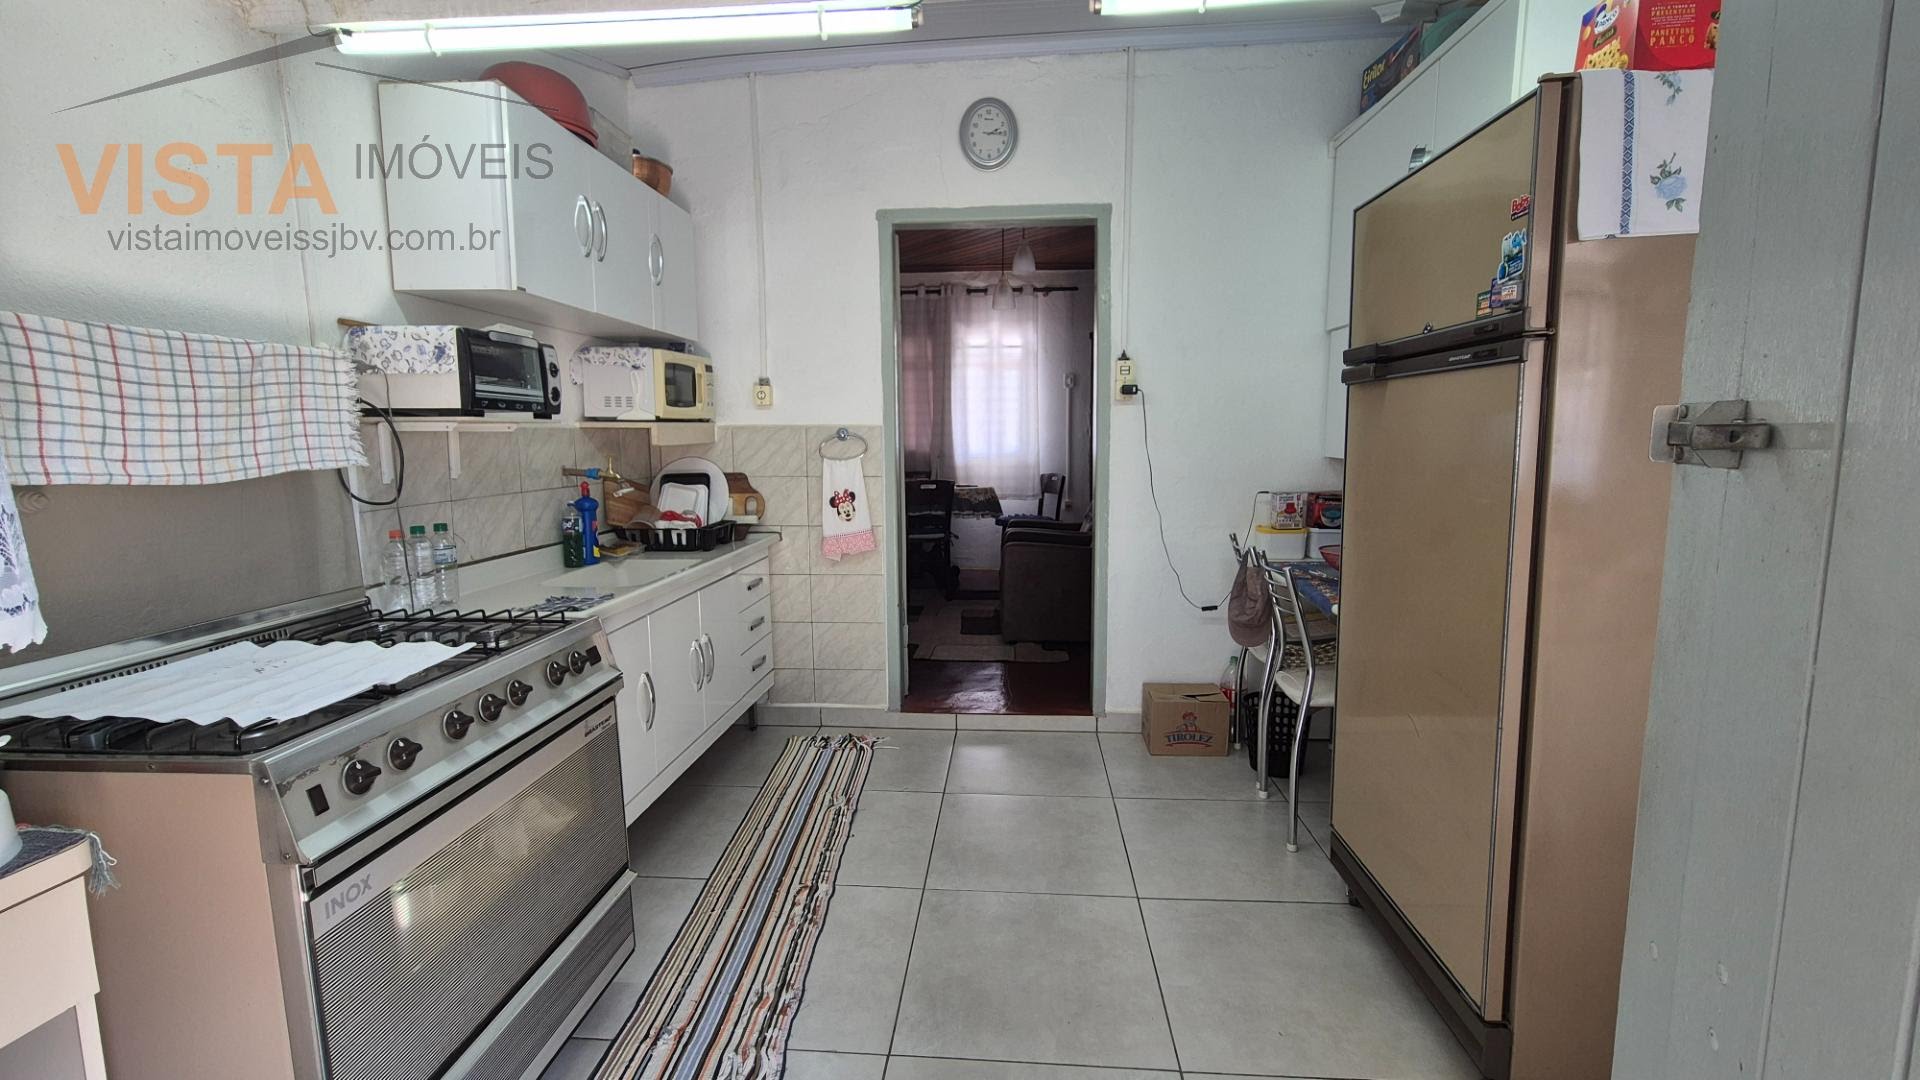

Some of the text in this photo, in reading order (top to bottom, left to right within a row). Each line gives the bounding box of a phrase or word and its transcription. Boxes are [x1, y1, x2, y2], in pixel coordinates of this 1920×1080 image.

[1650, 27, 1695, 37] PANETTONE
[1650, 35, 1695, 46] PANCO
[1167, 732, 1214, 744] TIROLEZ
[324, 873, 373, 920] INOX
